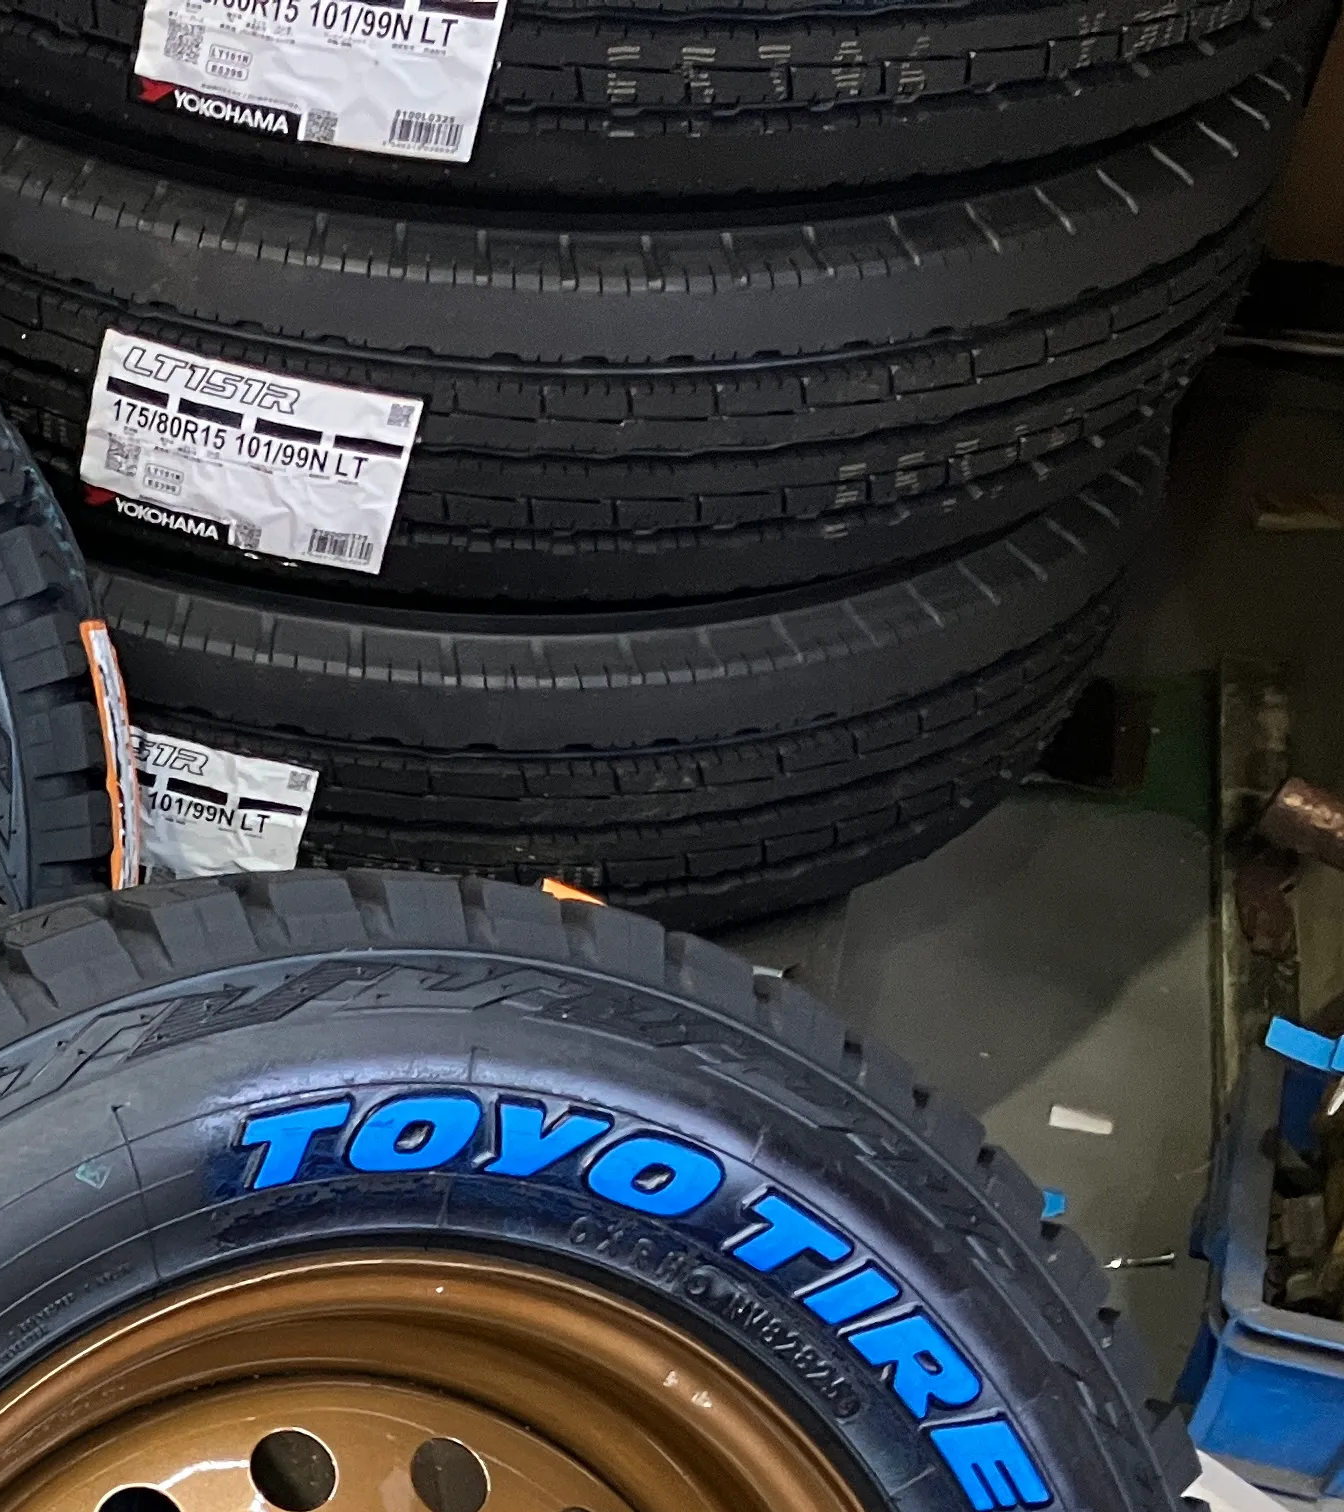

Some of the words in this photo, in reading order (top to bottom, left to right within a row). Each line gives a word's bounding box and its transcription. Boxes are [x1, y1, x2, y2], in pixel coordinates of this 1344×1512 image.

[308, 2, 415, 42] 101/99N
[420, 15, 459, 47] LT
[173, 89, 289, 134] YOKOHAMA
[123, 346, 301, 415] LT151R
[113, 399, 226, 451] 175/80R15
[234, 433, 329, 473] 101/99N
[334, 453, 369, 480] LT
[115, 497, 219, 541] YOKOHAMA
[145, 791, 235, 827] 101/99N
[240, 813, 271, 834] LT
[240, 1092, 725, 1219] TOYO
